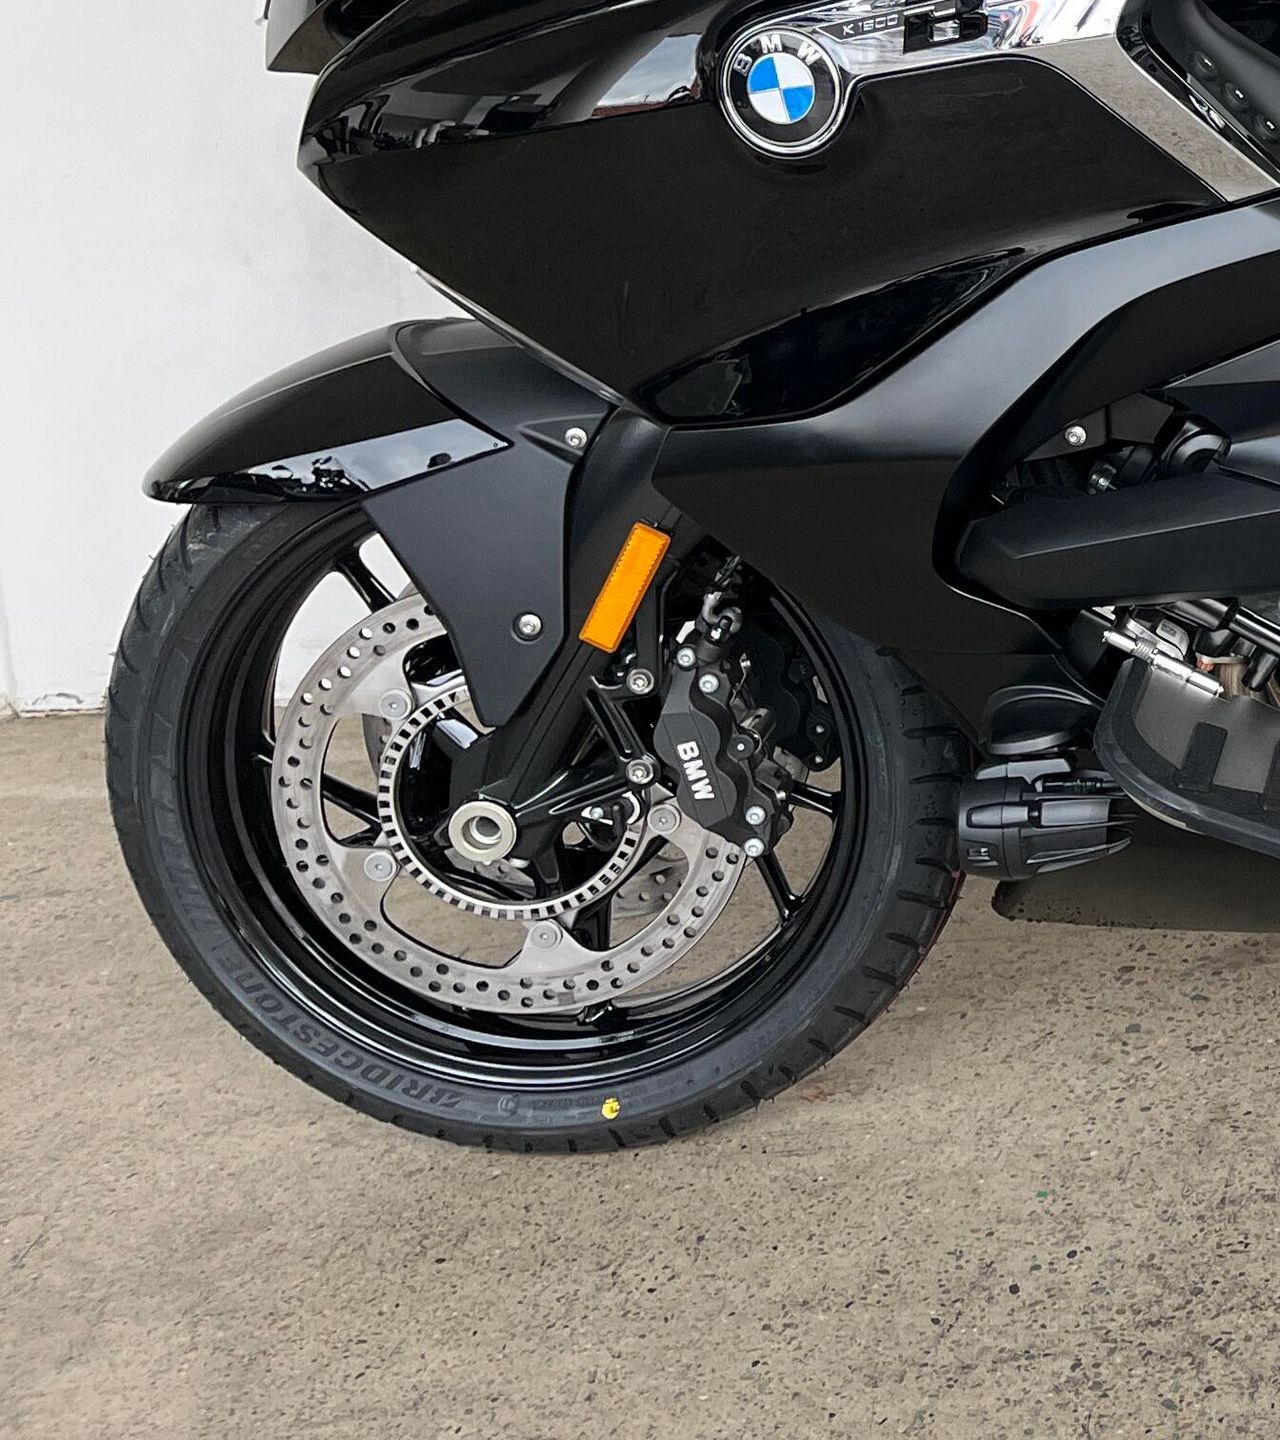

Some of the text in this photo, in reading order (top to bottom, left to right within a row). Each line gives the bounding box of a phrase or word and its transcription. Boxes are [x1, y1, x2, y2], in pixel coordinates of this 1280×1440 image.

[733, 33, 823, 77] BMW
[842, 23, 855, 37] K
[676, 740, 715, 800] BMW
[216, 950, 464, 1109] BRIDGESTONE
